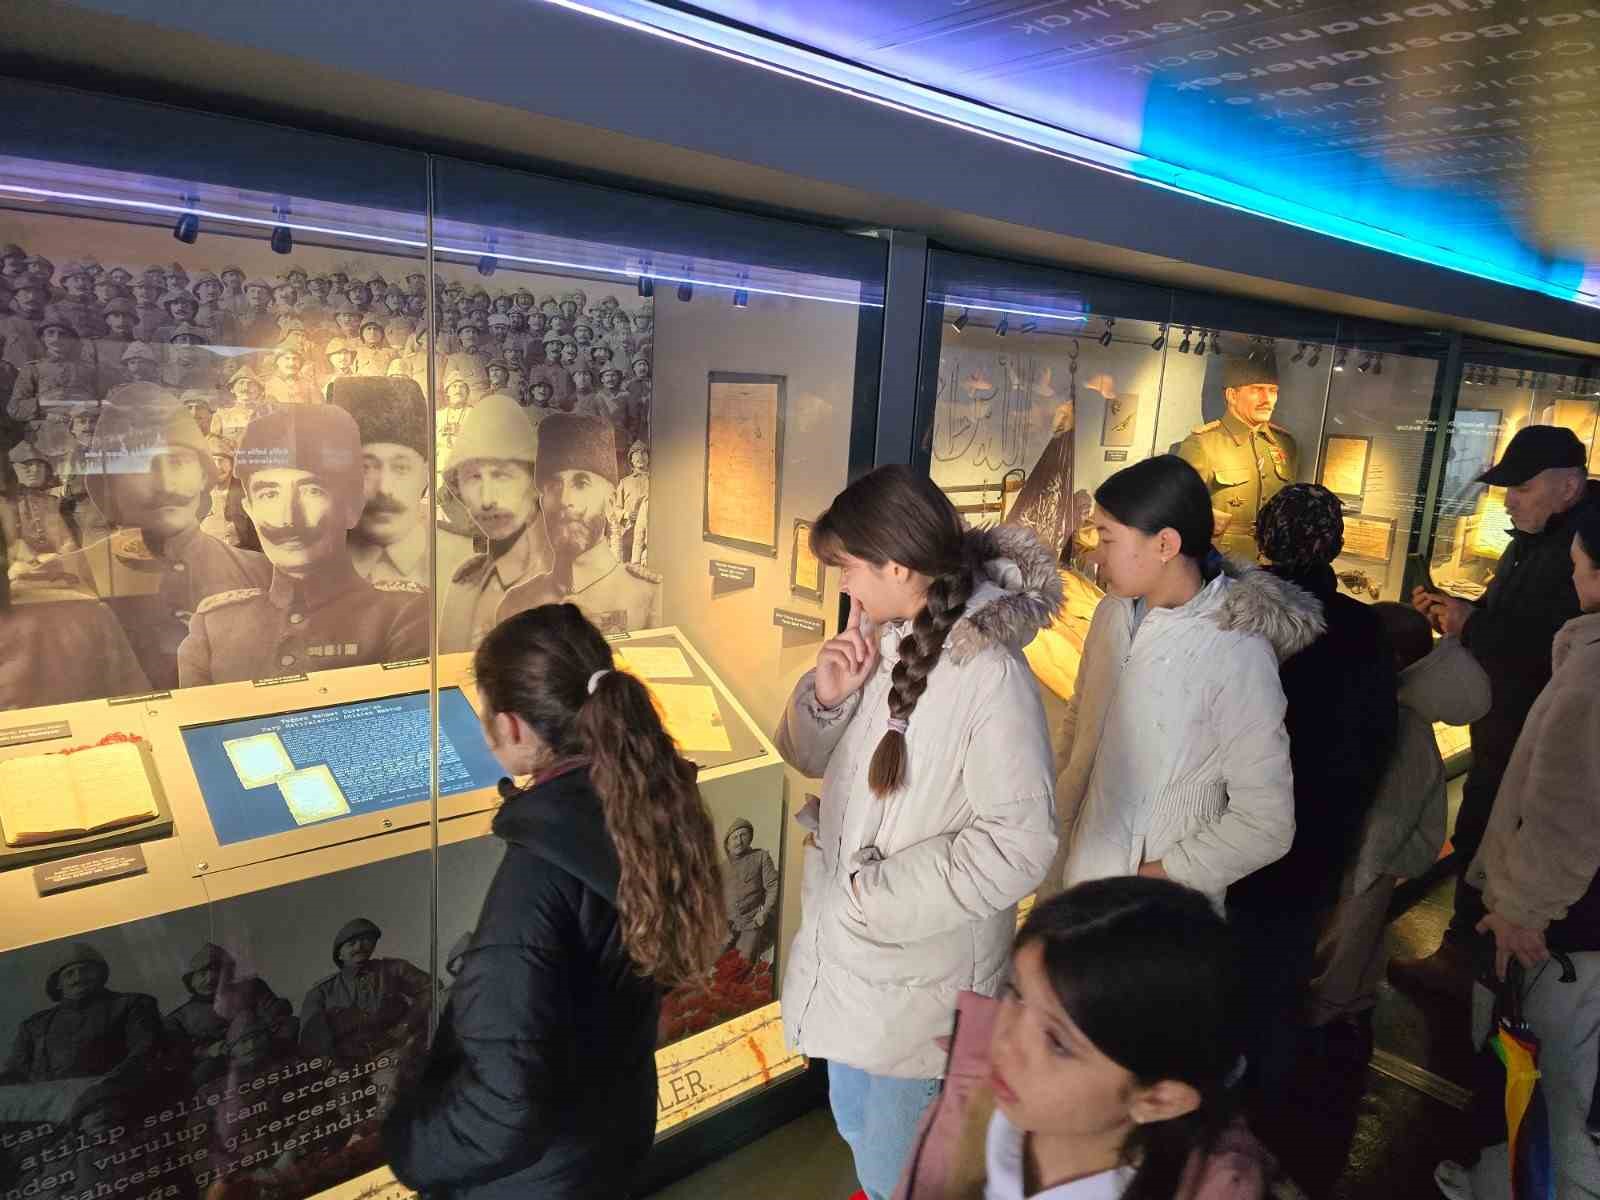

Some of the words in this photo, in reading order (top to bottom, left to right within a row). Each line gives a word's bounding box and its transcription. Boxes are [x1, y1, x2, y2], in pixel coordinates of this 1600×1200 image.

[93, 1123, 208, 1170] vurulup
[225, 1101, 269, 1125] tam
[281, 1055, 399, 1104] ercesine,
[144, 1057, 334, 1128] sellercesine,
[224, 1082, 388, 1151] girercesine,
[195, 1105, 378, 1188] girenlerindir
